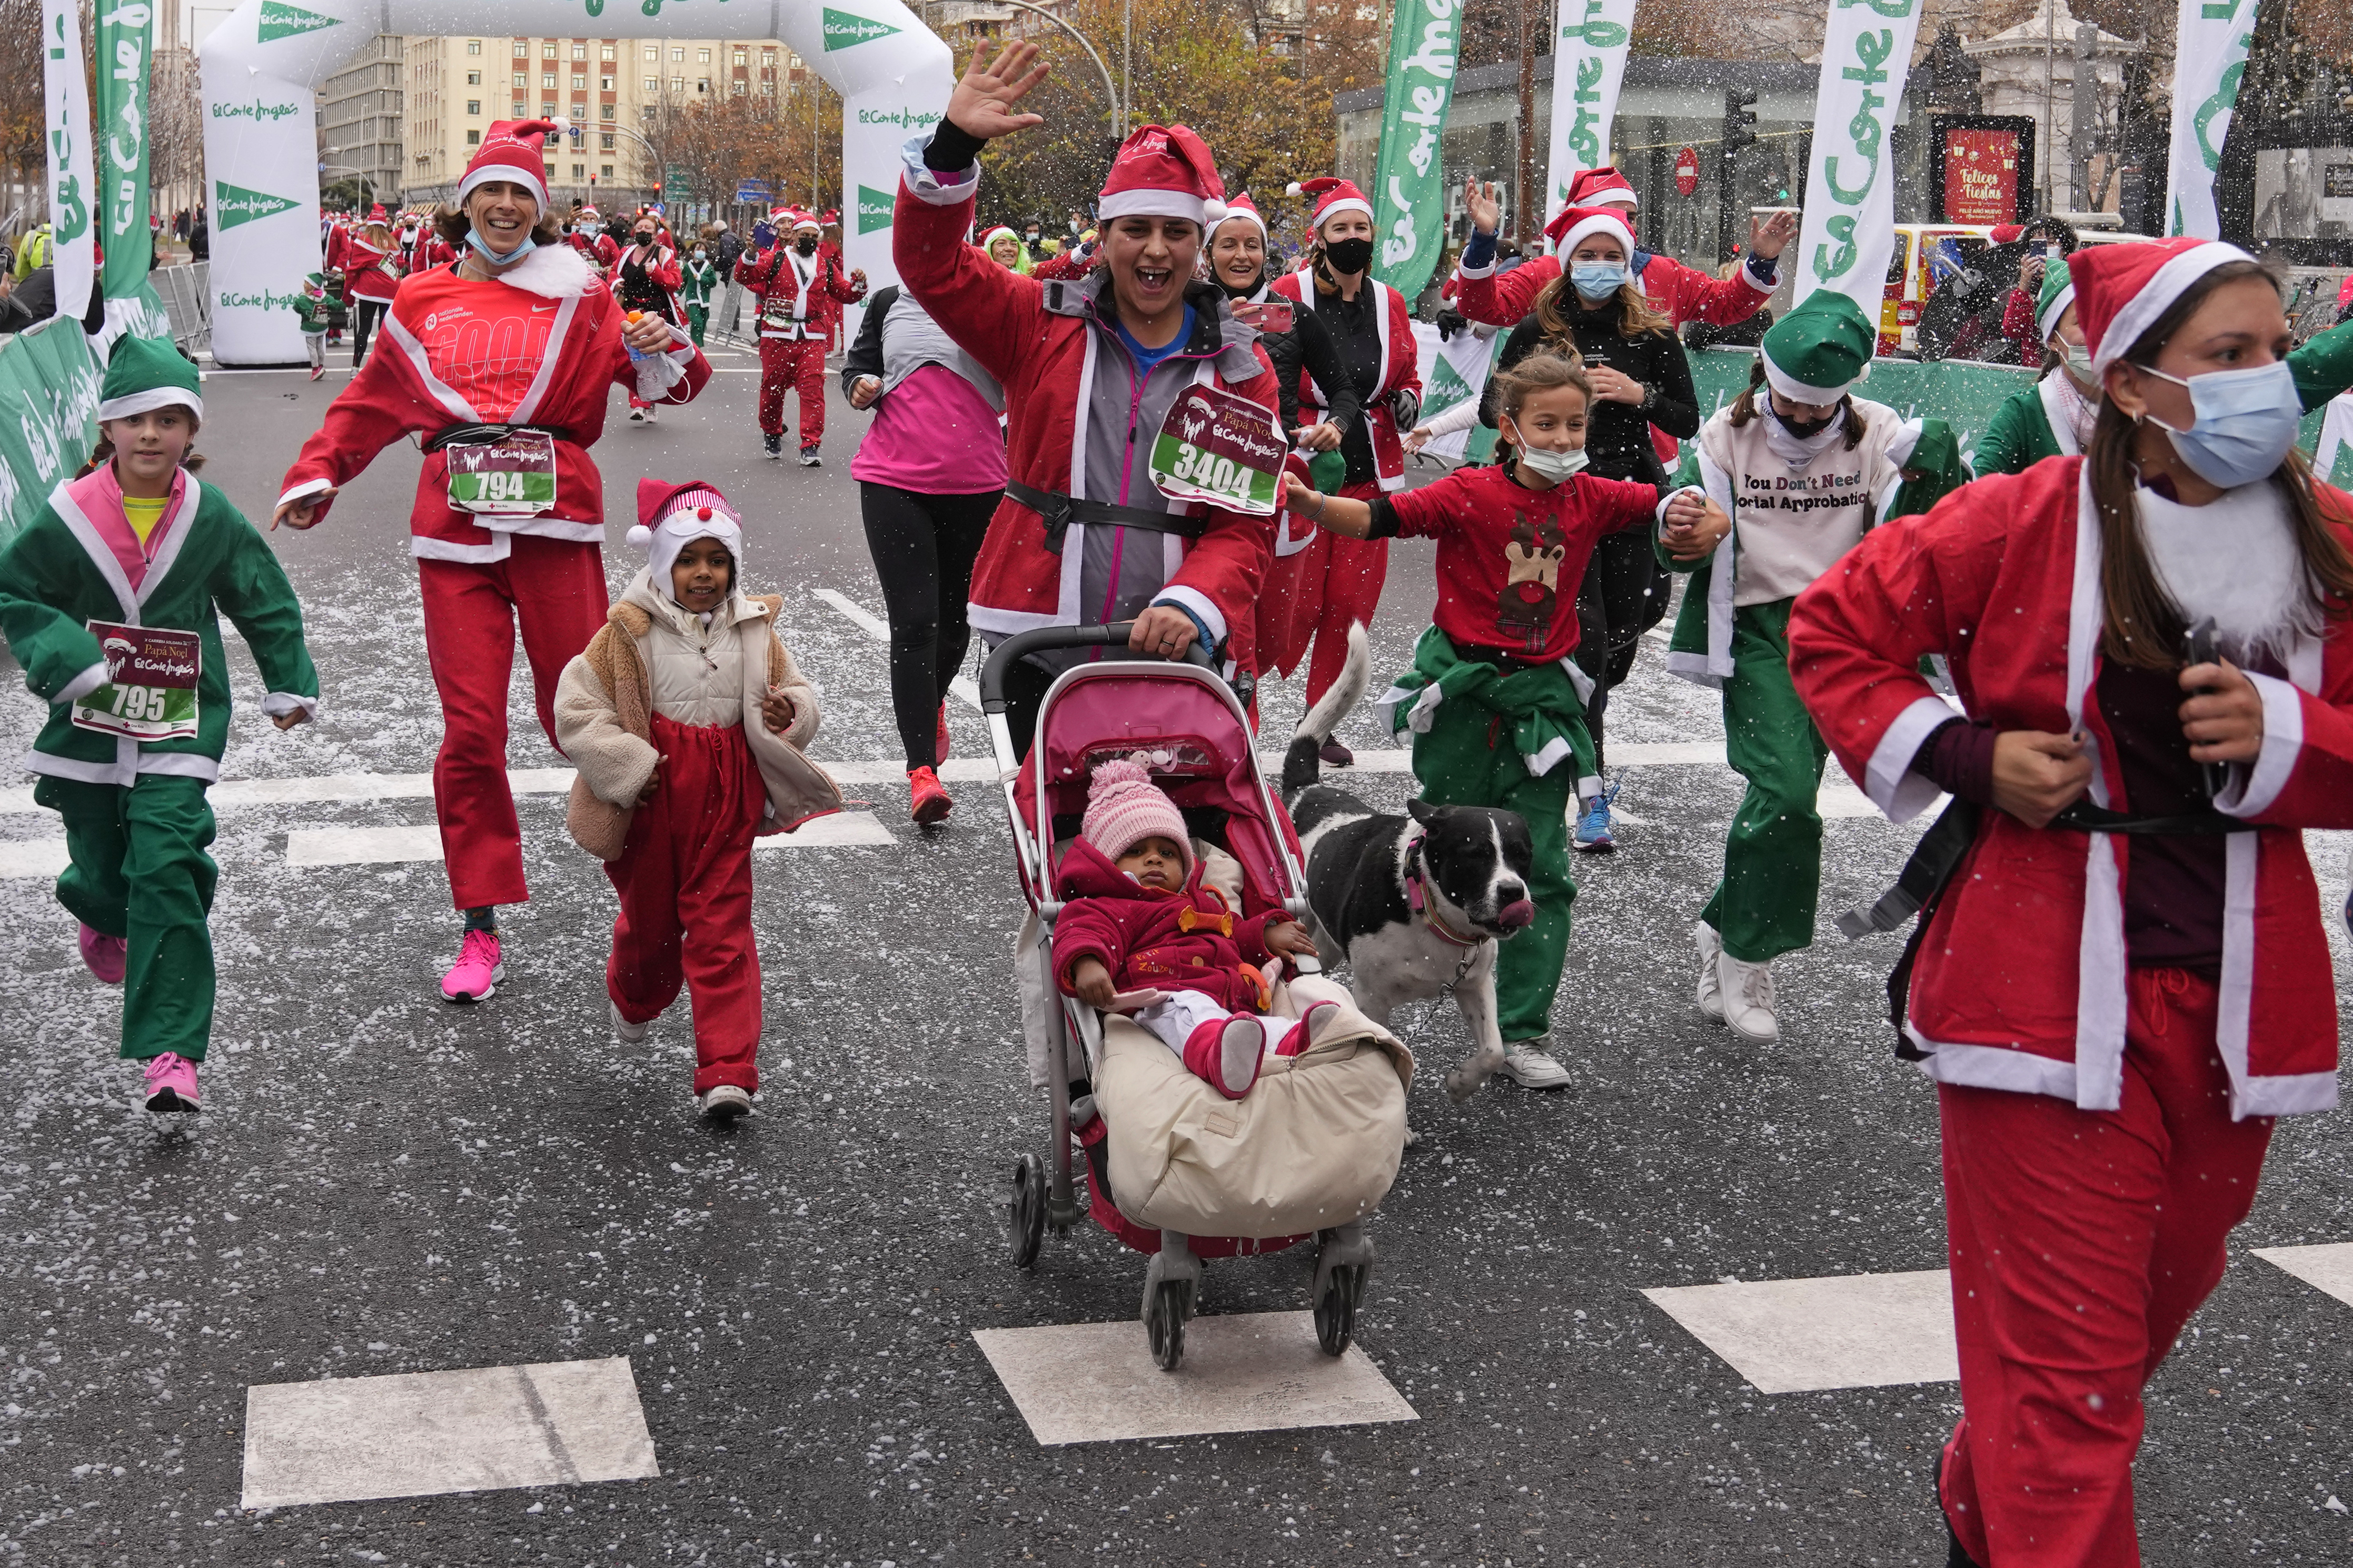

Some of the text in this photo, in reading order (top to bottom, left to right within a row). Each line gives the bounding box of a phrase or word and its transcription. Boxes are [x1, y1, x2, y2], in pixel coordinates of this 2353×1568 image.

[835, 24, 857, 34] Corte
[857, 21, 889, 37] Inglés
[213, 98, 299, 121] El Corte Inglés
[870, 109, 900, 123] Corte
[902, 106, 942, 128] Inglés
[1825, 29, 1893, 206] Corte
[1960, 168, 1999, 185] Felices
[1963, 184, 2001, 200] Fiestas
[226, 199, 248, 211] Corte
[249, 195, 285, 214] Inglés
[868, 204, 891, 215] Corte
[221, 293, 230, 306] El
[232, 293, 262, 306] Corte
[438, 306, 463, 317] nationale
[439, 311, 473, 323] nederlanden
[1229, 407, 1251, 418] CARRERA
[1223, 411, 1276, 441] Papá Noe
[1213, 424, 1279, 459] El Corte Inglés
[490, 448, 549, 463] El Corte Inglés
[1173, 443, 1254, 499] 3404
[475, 472, 525, 501] 794
[1775, 476, 1818, 491] Don't
[1821, 471, 1861, 488] Need
[1736, 491, 1867, 513] ocial Approbatio
[144, 644, 188, 660] Papá Noel
[135, 657, 195, 676] El Corte Inglés
[111, 684, 167, 722] 795
